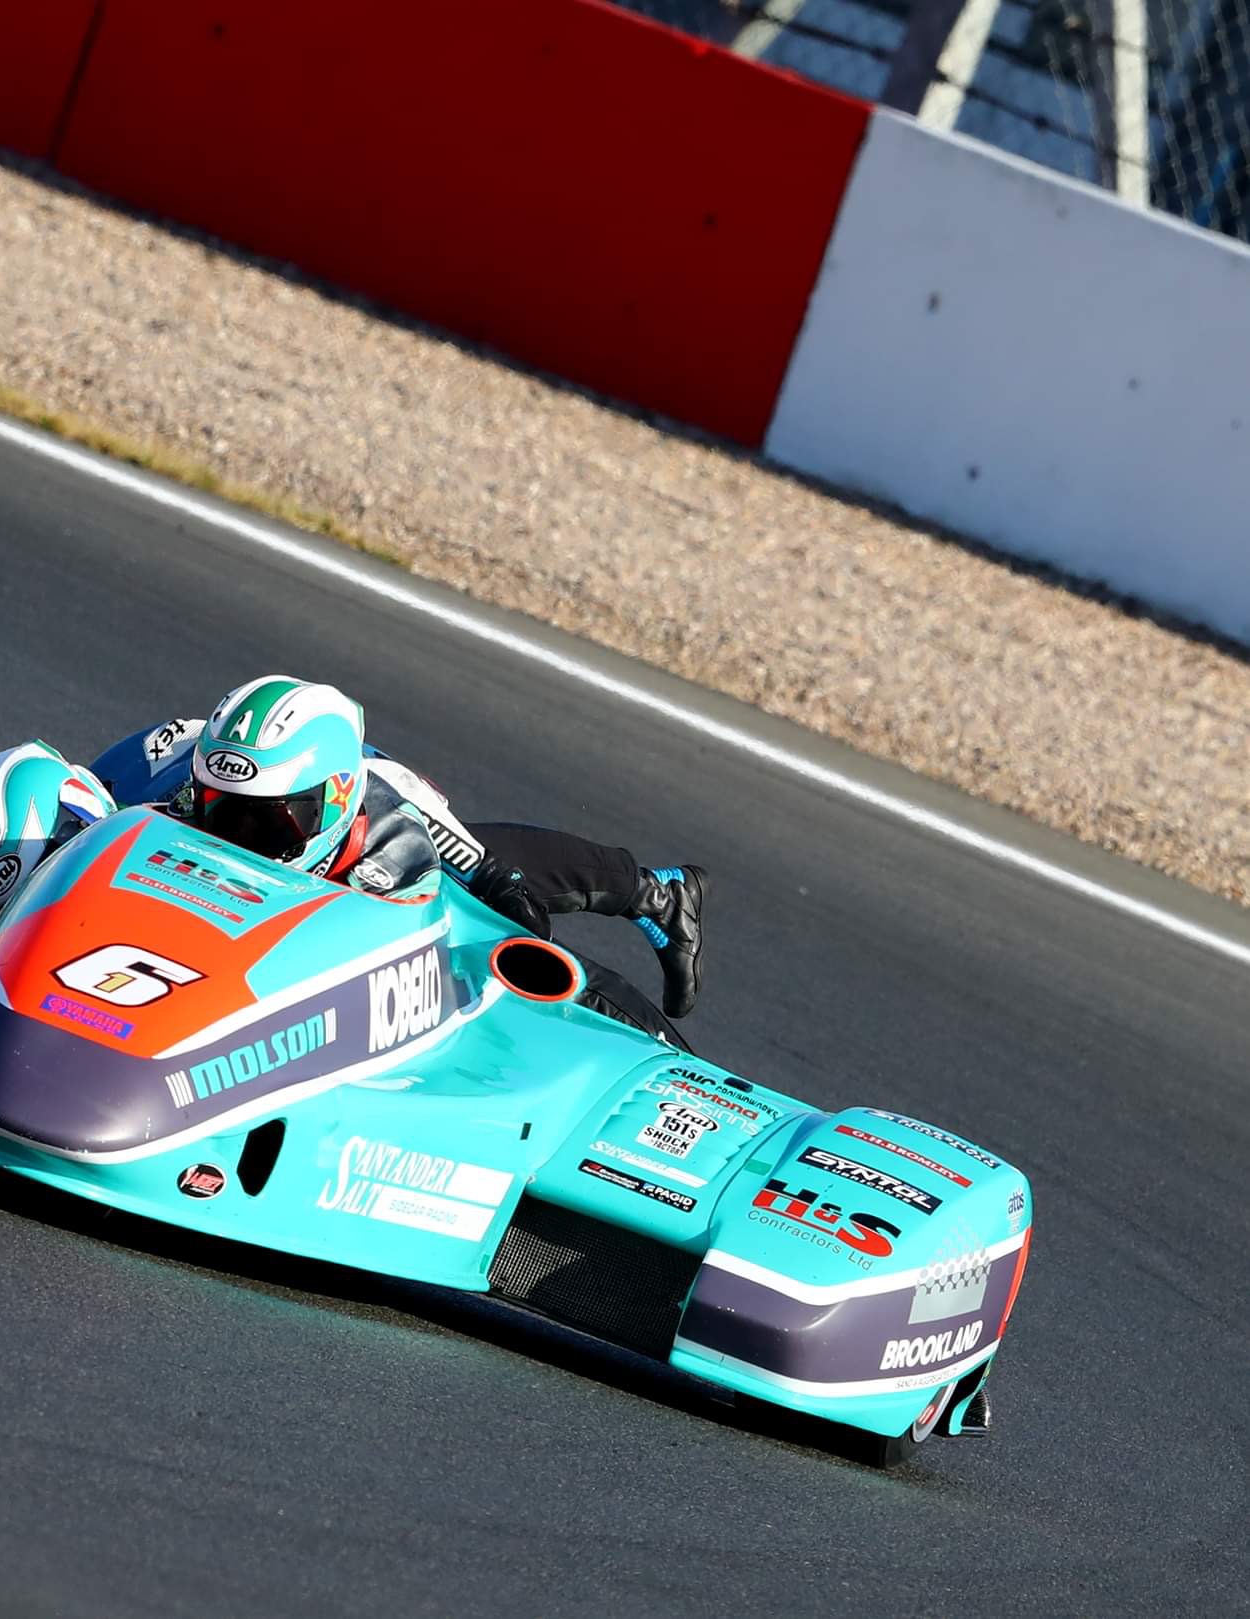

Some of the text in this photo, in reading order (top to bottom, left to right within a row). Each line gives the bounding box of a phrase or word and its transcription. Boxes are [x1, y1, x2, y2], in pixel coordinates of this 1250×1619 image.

[208, 752, 252, 777] Arai
[50, 943, 207, 1008] 6
[368, 945, 442, 1053] KOBELCO
[66, 1000, 125, 1035] YAMAHA
[643, 1127, 691, 1150] SHOCK
[328, 1136, 455, 1200] SANTANDER
[805, 1150, 931, 1210] SYNTOL
[824, 1165, 912, 1203] LUBRICANTS
[654, 1187, 694, 1207] PAGID
[748, 1210, 874, 1271] Contractors Ltd
[879, 1320, 984, 1371] BROOKLAND
